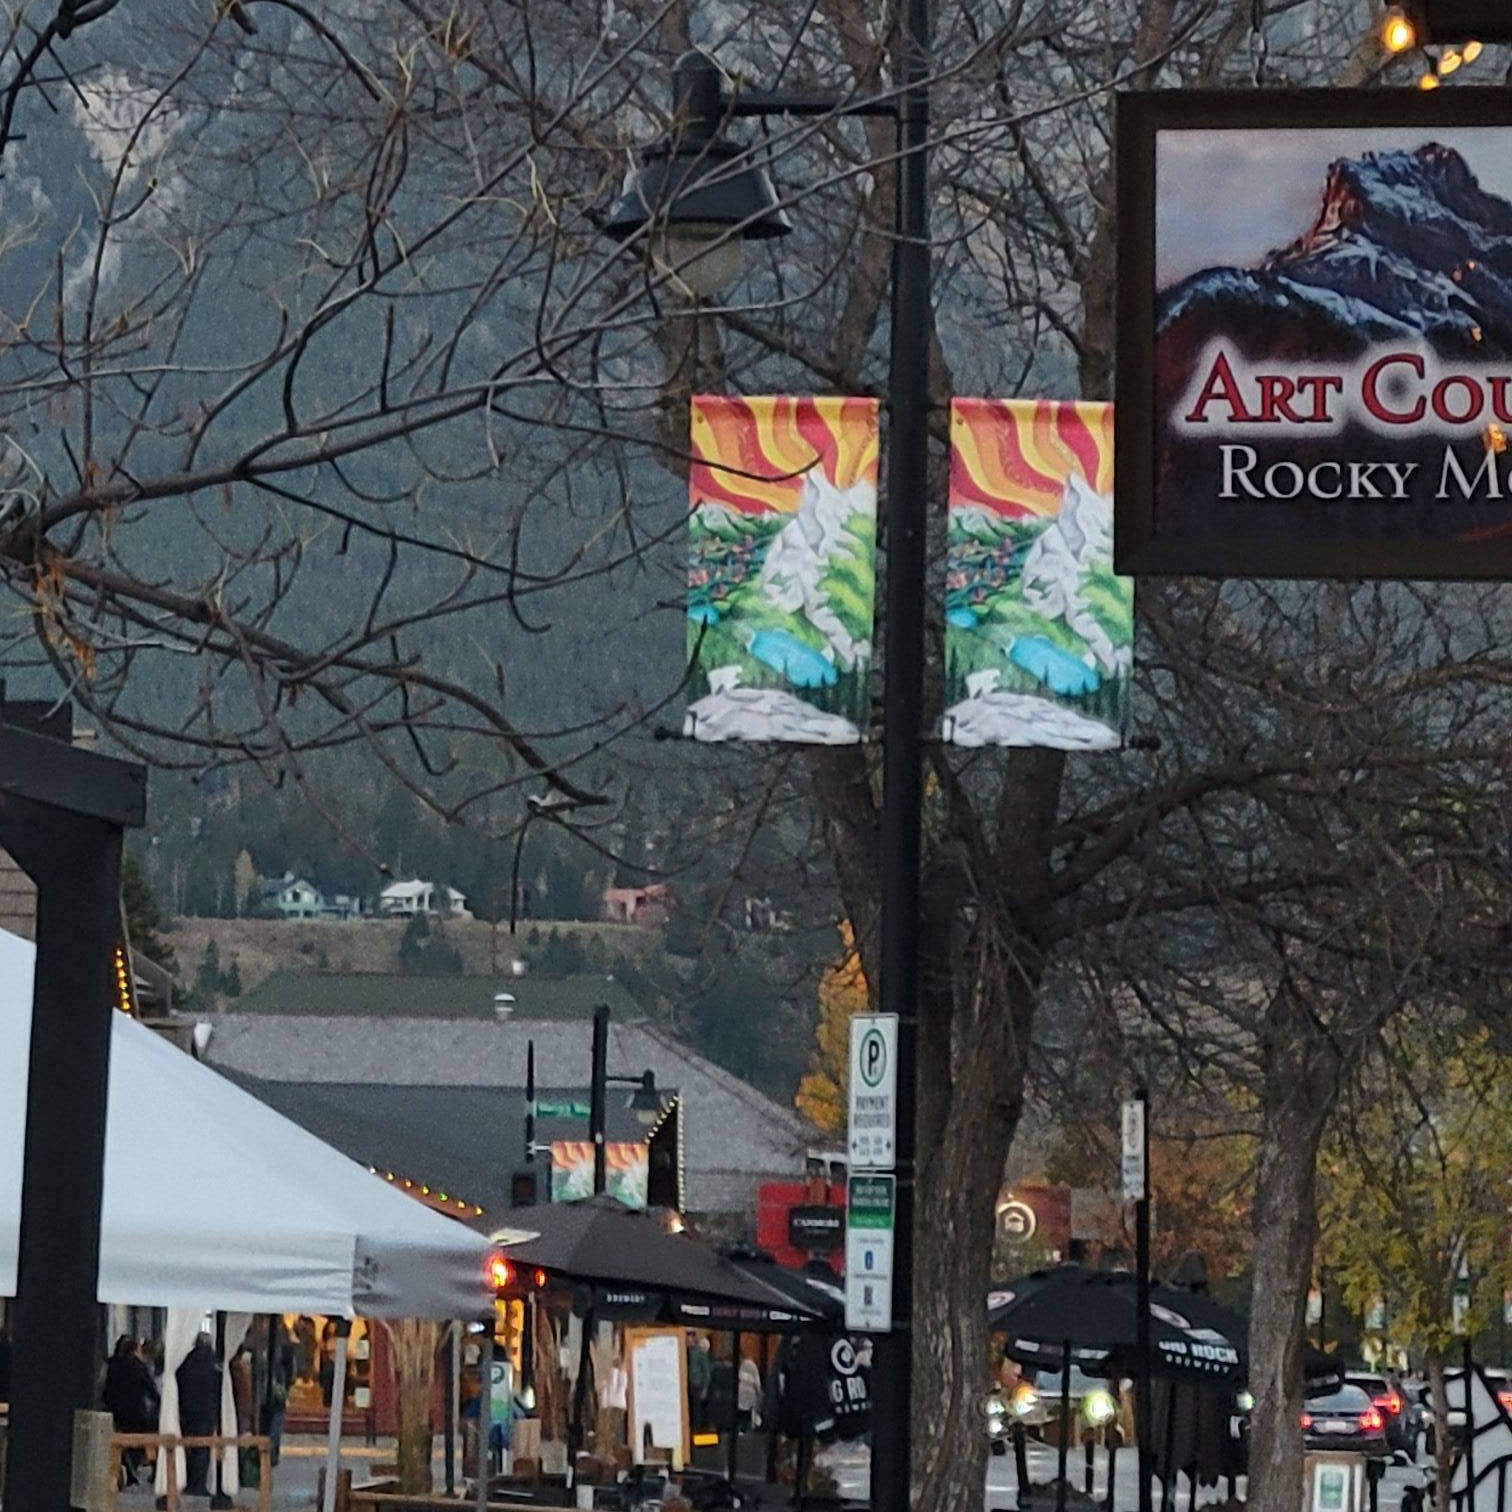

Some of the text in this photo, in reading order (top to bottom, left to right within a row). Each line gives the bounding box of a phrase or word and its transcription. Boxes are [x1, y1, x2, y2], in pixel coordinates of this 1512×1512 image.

[1185, 350, 1343, 423] ART
[1217, 443, 1512, 499] ROCKY M
[868, 1039, 880, 1077] P
[1190, 1342, 1239, 1365] ROCK
